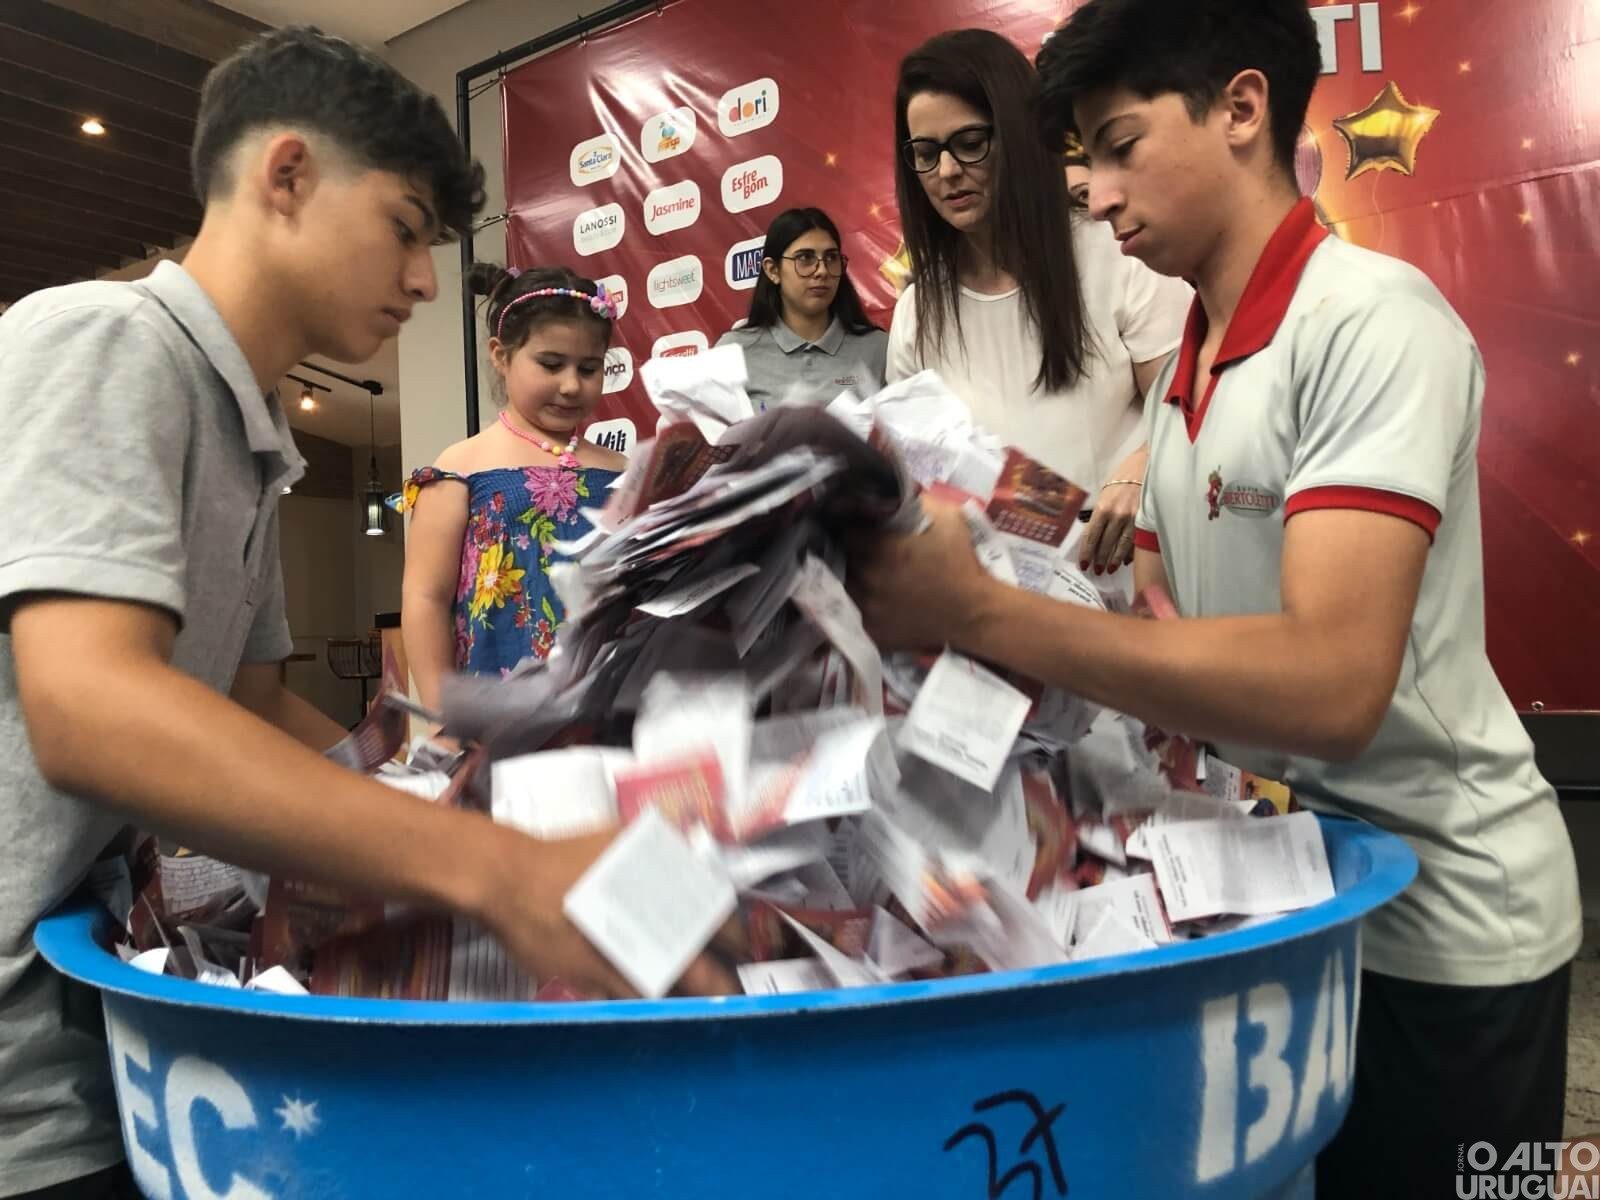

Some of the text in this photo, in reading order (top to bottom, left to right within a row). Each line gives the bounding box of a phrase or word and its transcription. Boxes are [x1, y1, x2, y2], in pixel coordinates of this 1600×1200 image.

[1308, 2, 1382, 74] TI
[729, 90, 767, 123] dori
[579, 157, 597, 168] Santa
[596, 152, 612, 164] Clara
[732, 170, 757, 192] Esfre
[744, 176, 769, 200] Bom
[651, 197, 696, 222] Jasmine
[580, 214, 617, 234] LANOSSI
[654, 269, 696, 292] lightsweet
[596, 429, 626, 452] Mili
[1196, 946, 1362, 1184] BA
[103, 1008, 272, 1200] EC
